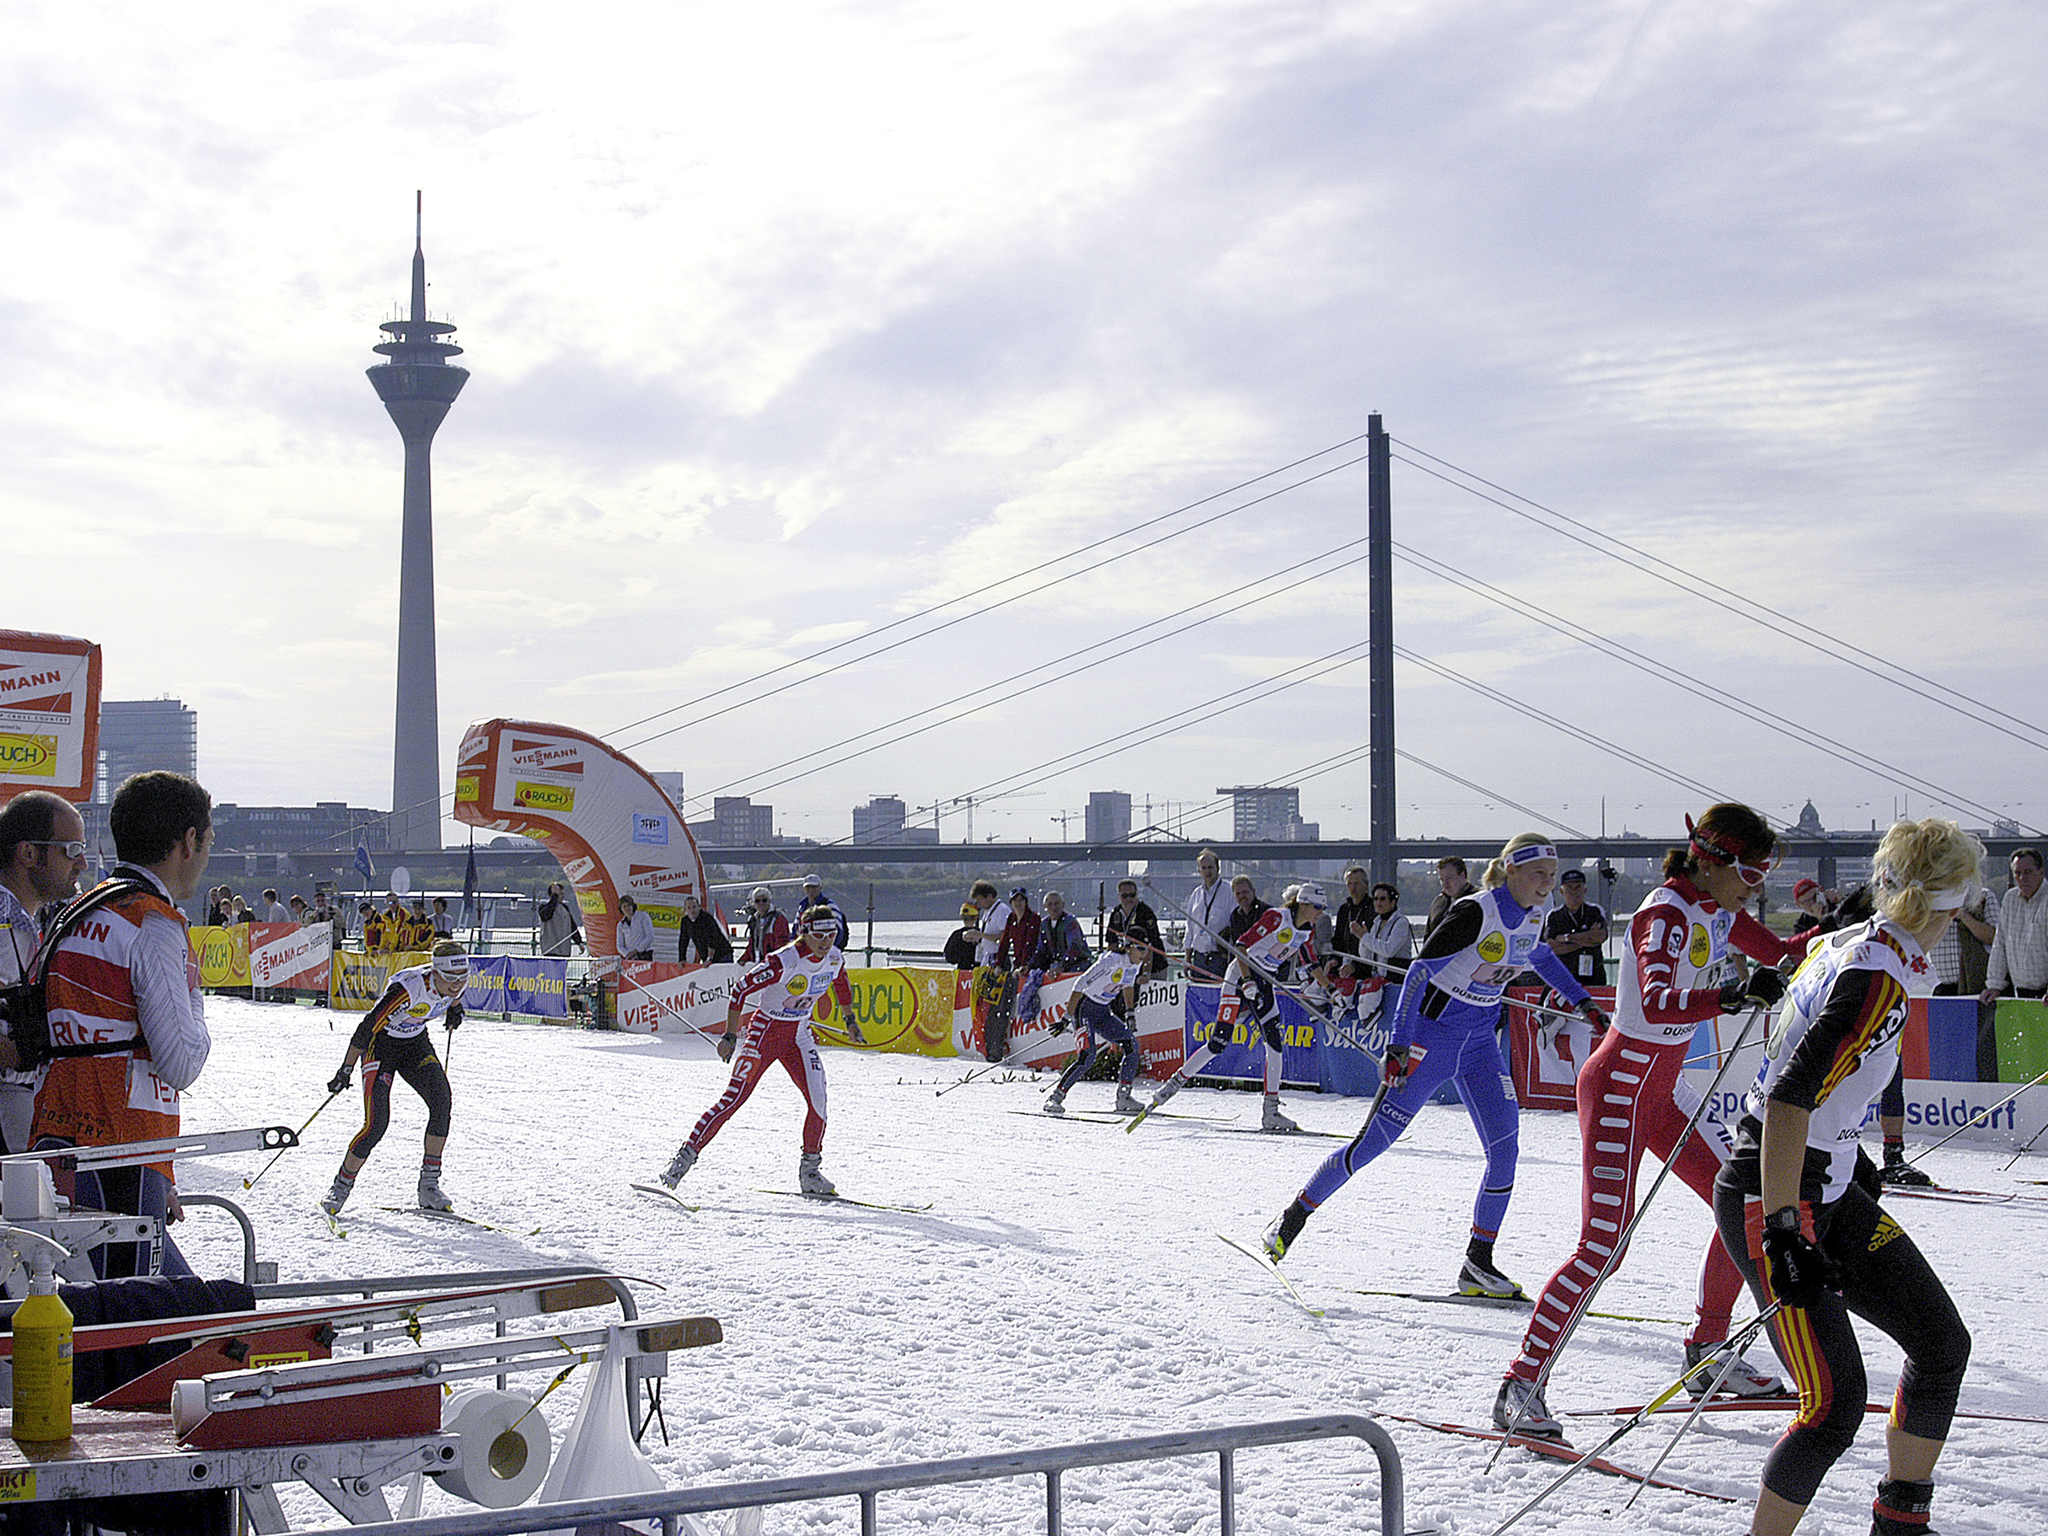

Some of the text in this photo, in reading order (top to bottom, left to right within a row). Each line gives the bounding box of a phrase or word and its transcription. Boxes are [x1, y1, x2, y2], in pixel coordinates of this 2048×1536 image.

[0, 746, 37, 762] UCH
[531, 791, 563, 804] RAUCH
[507, 972, 564, 995] GOODYEAR
[1222, 1006, 1233, 1021] 8
[734, 1058, 753, 1079] 12
